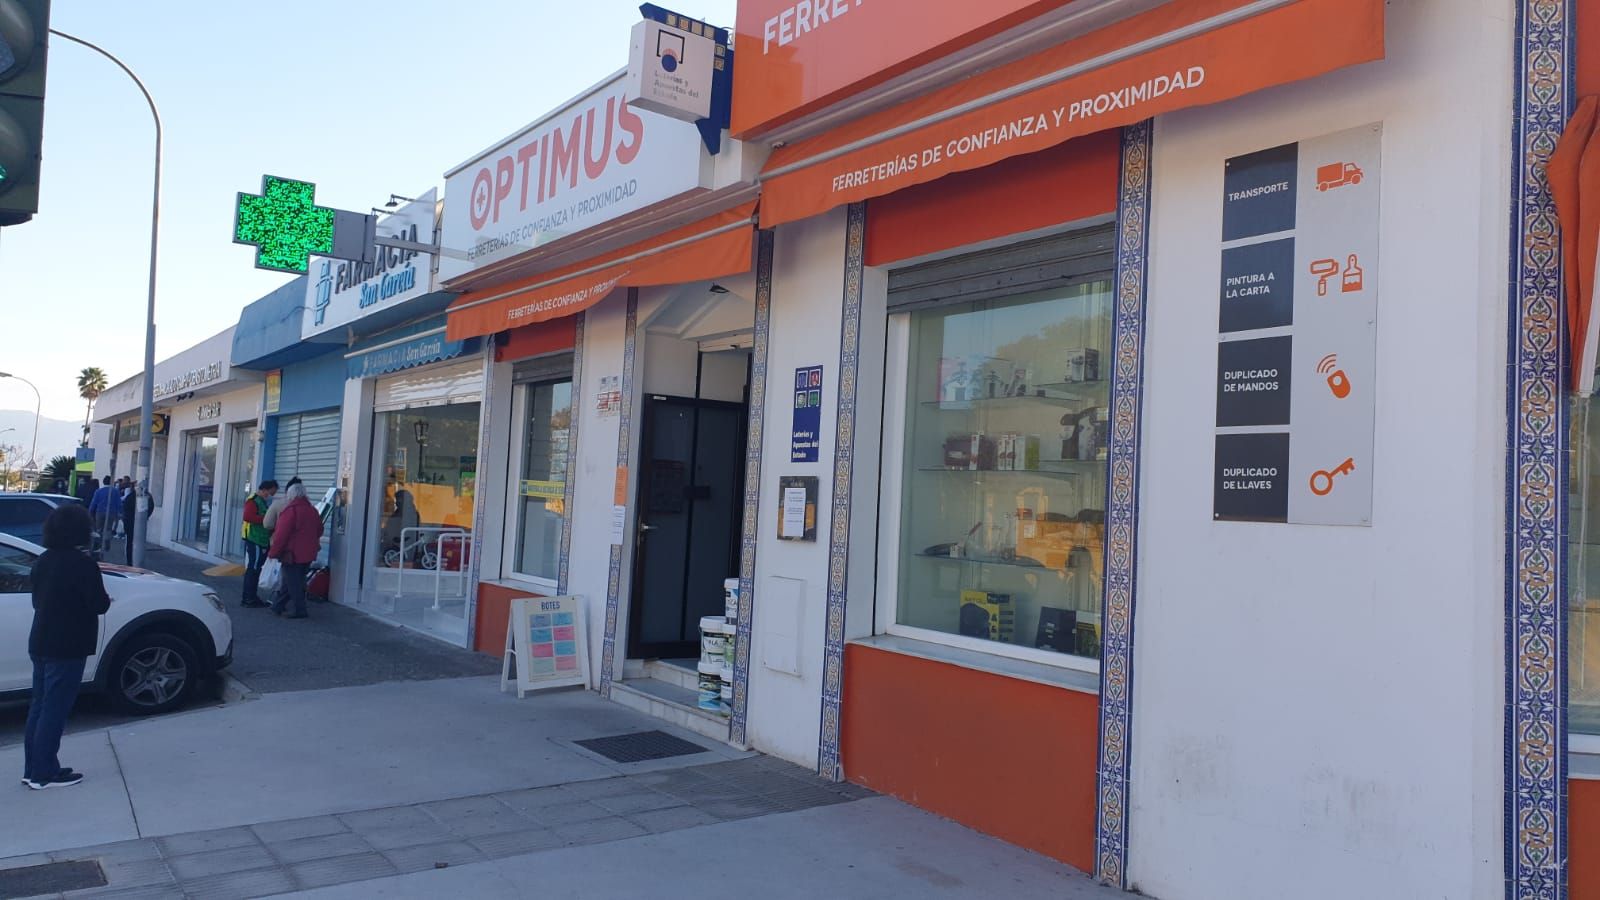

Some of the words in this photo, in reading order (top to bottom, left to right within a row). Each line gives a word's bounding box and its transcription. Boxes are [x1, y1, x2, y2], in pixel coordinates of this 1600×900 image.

[763, 0, 862, 55] FERRE
[831, 155, 918, 193] FERRETERÍAS
[921, 145, 943, 169] DE
[945, 113, 1049, 158] CONFIANZA
[1053, 107, 1065, 128] Y
[1067, 65, 1206, 122] PROXIMIDAD
[469, 92, 644, 232] OPTIMUS
[1228, 181, 1289, 202] TRANSPORTE
[466, 236, 509, 261] FERRETERÍAS
[509, 228, 521, 245] DE
[521, 211, 569, 241] CONFIANZA
[570, 205, 577, 222] Y
[577, 178, 638, 218] PROXIMIDAD
[334, 223, 419, 295] FARMACIA
[359, 282, 379, 309] San
[380, 261, 417, 301] García
[1226, 274, 1266, 287] PINTURA
[1267, 271, 1276, 281] A
[1226, 288, 1238, 299] LA
[1239, 285, 1271, 297] CARTA
[507, 300, 544, 320] FERRETERÍAS
[543, 298, 553, 310] DE
[552, 289, 588, 308] CONFIANZA
[588, 286, 595, 299] Y
[406, 346, 420, 361] San
[1224, 368, 1278, 380] DUPLICADO
[1223, 383, 1236, 393] DE
[1237, 381, 1279, 392] MANDOS
[1223, 467, 1278, 477] DUPLICADO
[1223, 480, 1236, 490] DE
[1237, 480, 1272, 490] LLAVES
[541, 600, 561, 610] BOTES
